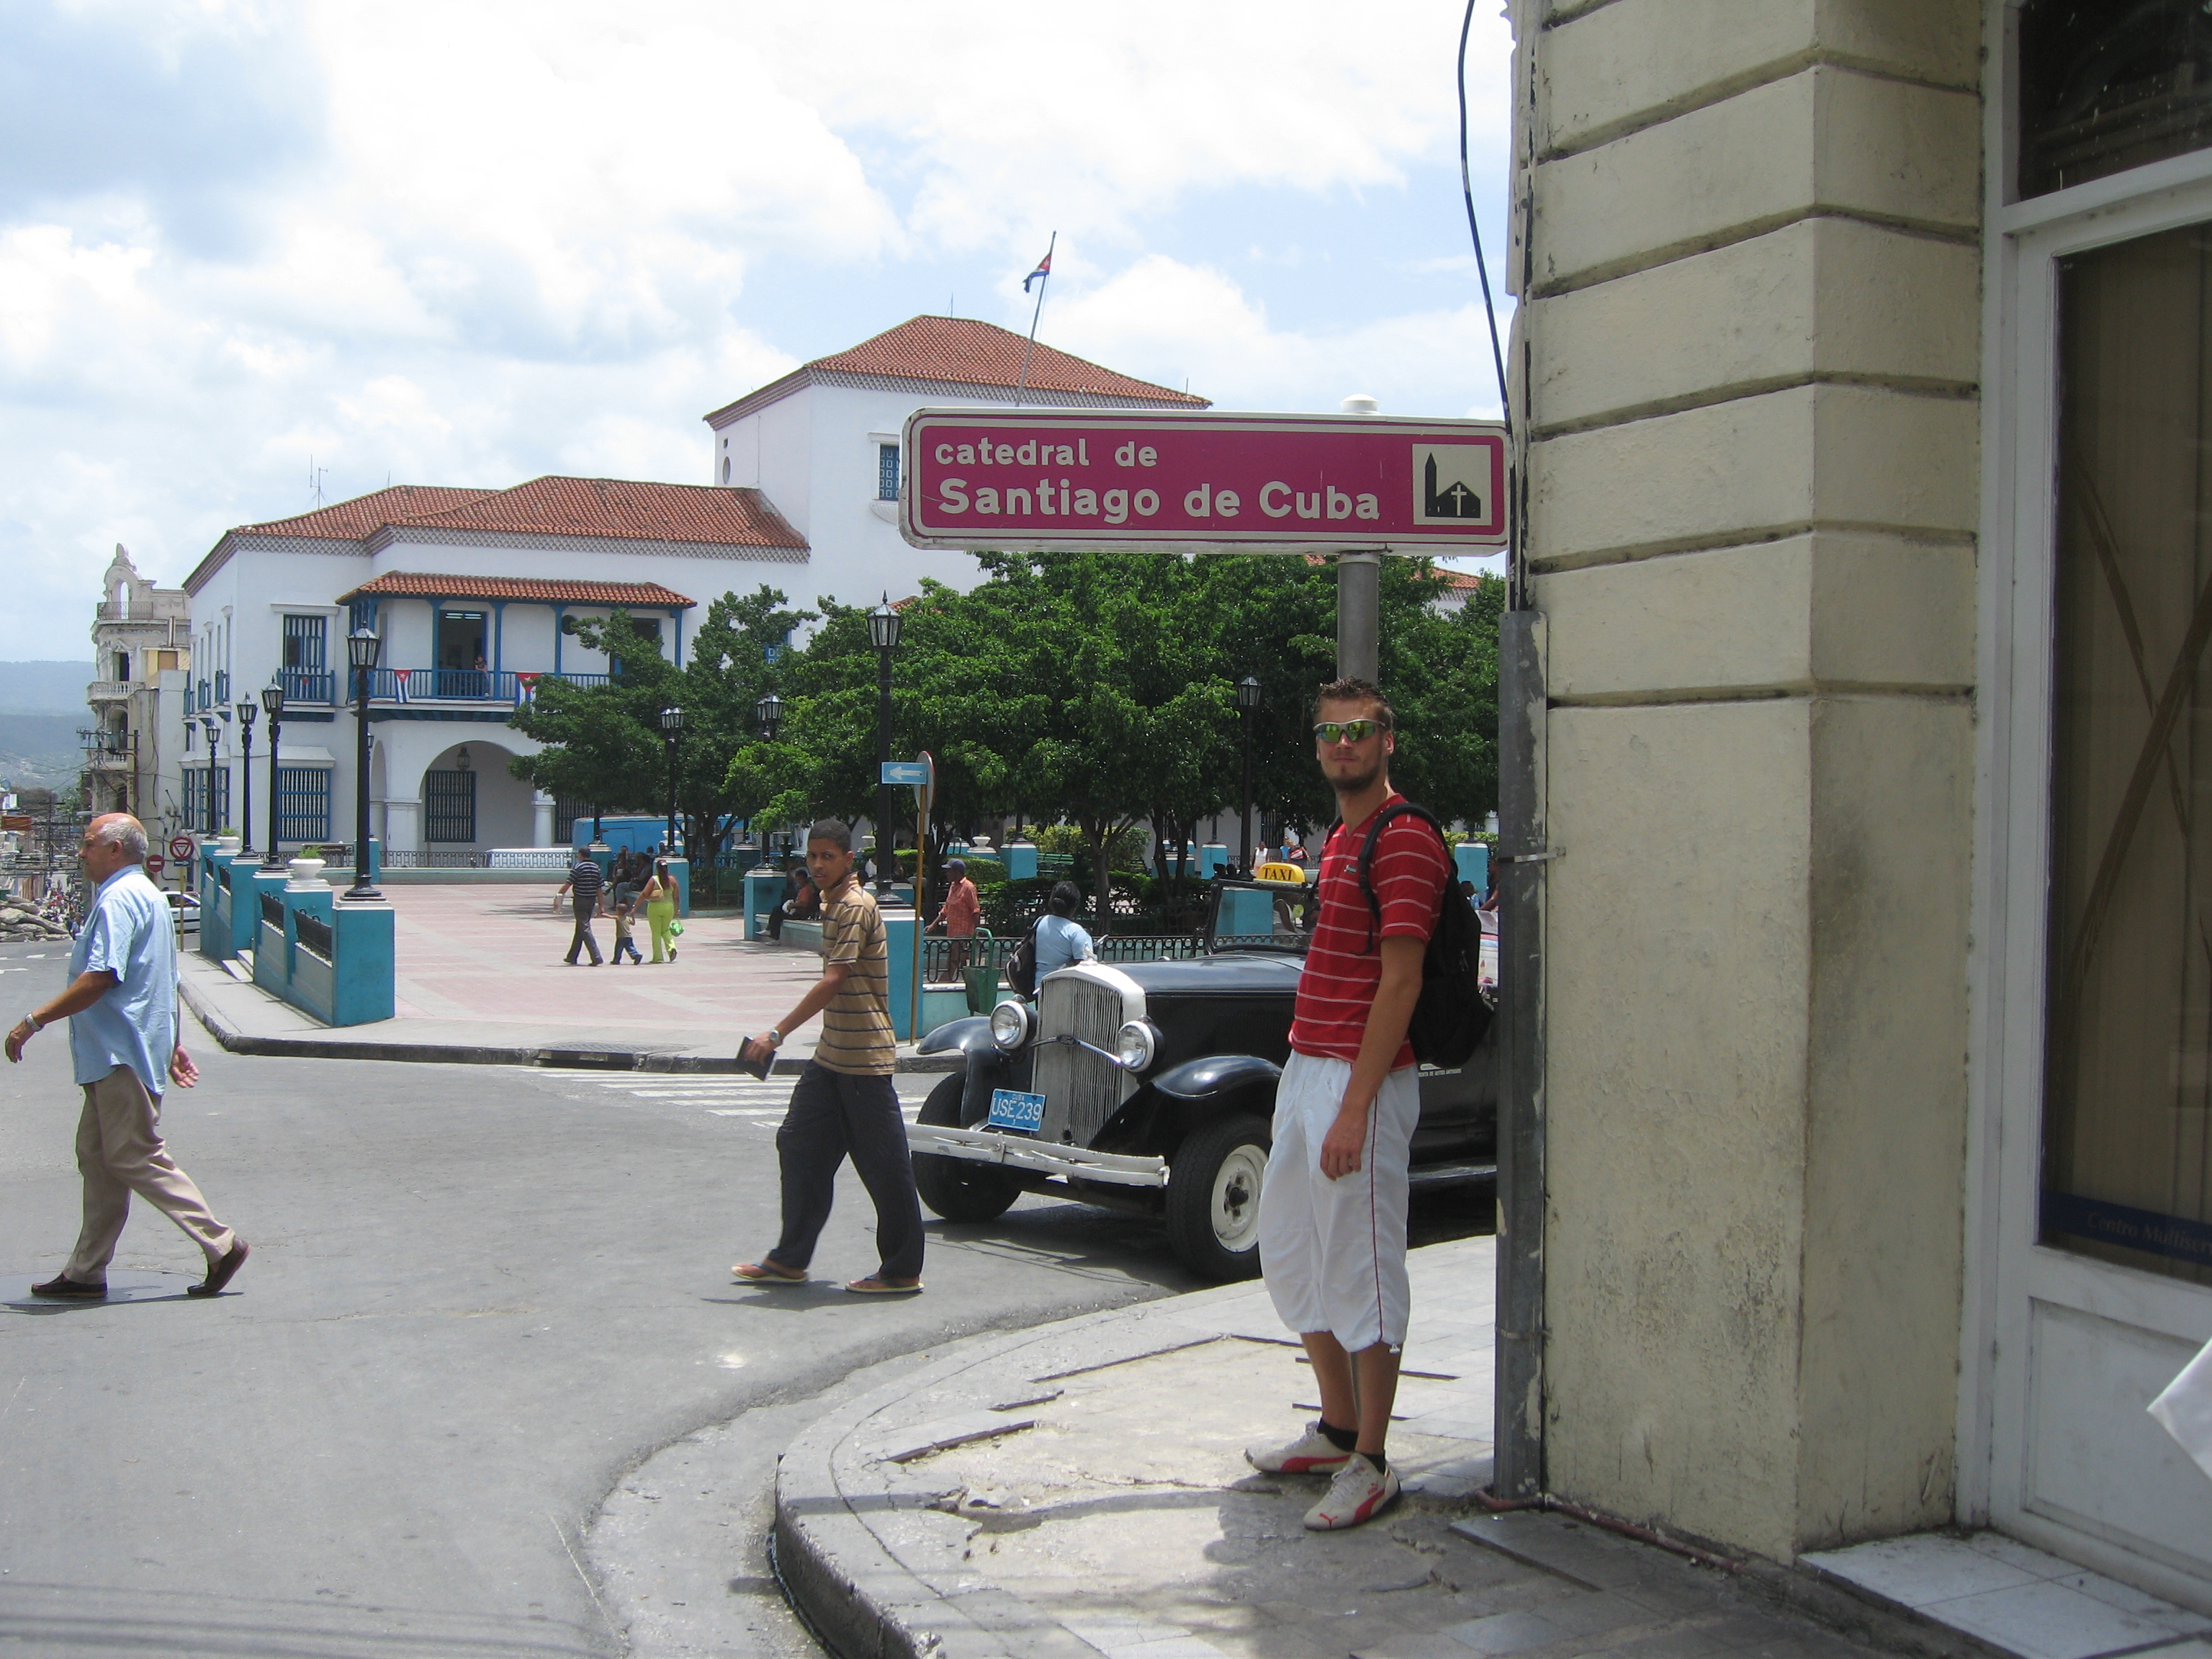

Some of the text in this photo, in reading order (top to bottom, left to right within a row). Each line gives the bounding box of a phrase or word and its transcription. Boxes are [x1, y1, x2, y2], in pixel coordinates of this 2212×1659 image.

[935, 436, 1158, 467] catedral de
[938, 477, 1380, 524] Santiago de Cuba
[1263, 867, 1293, 881] TAXI
[992, 1097, 1042, 1121] USE239
[1012, 1093, 1025, 1102] CUBA
[2087, 1212, 2139, 1237] Centro
